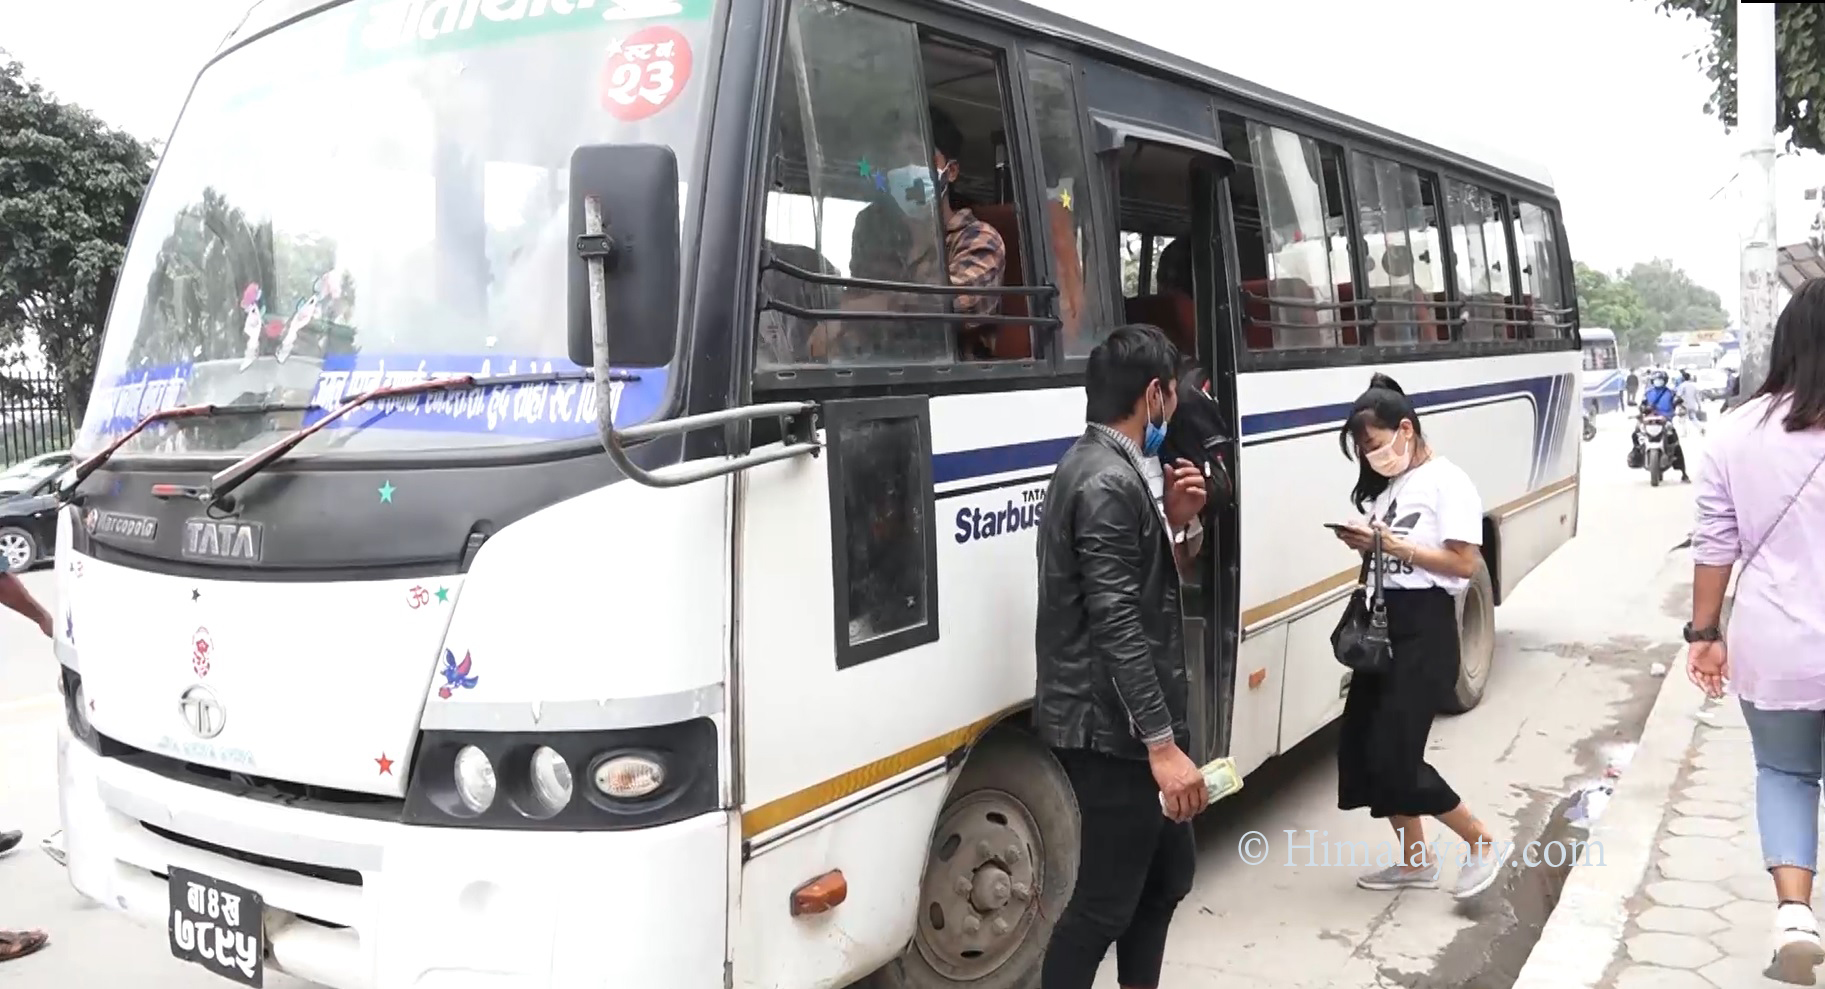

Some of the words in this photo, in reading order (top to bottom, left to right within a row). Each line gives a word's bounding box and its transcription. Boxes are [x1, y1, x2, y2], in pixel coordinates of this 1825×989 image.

[607, 60, 676, 105] २३
[188, 522, 254, 558] TATA
[955, 500, 1044, 544] Starbus
